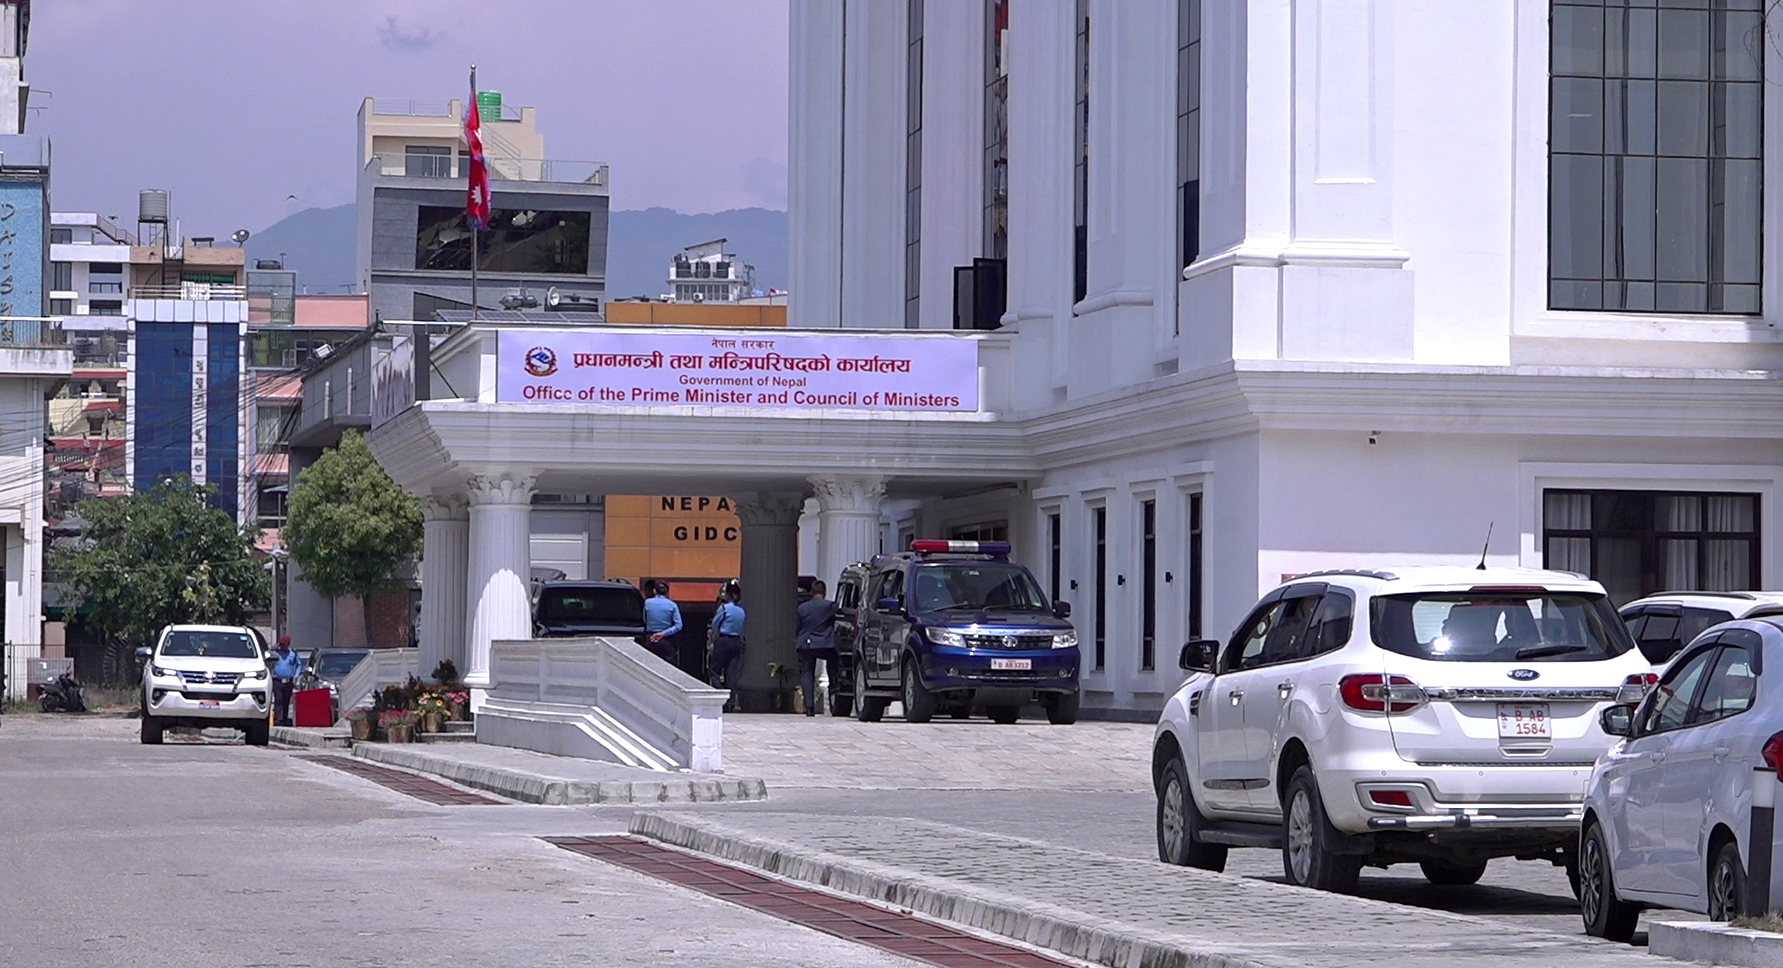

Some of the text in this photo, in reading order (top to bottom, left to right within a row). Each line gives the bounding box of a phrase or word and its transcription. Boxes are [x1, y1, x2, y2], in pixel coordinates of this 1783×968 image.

[711, 337, 775, 350] नेपाल सरकार
[574, 350, 911, 373] प्रधानमन्त्री तथा मन्त्रिपरिषदको कार्यालय
[679, 375, 806, 388] Government of Nepal
[578, 387, 595, 400] of
[599, 387, 625, 401] the
[632, 388, 679, 402] Prime
[686, 389, 752, 403] Minister
[758, 391, 787, 404] and
[794, 391, 856, 405] Council
[863, 392, 879, 405] of
[885, 392, 959, 406] Ministers
[674, 526, 737, 541] GIDC
[1515, 670, 1533, 678] Ford
[1515, 710, 1545, 722] B AB
[1516, 723, 1546, 735] 1584
